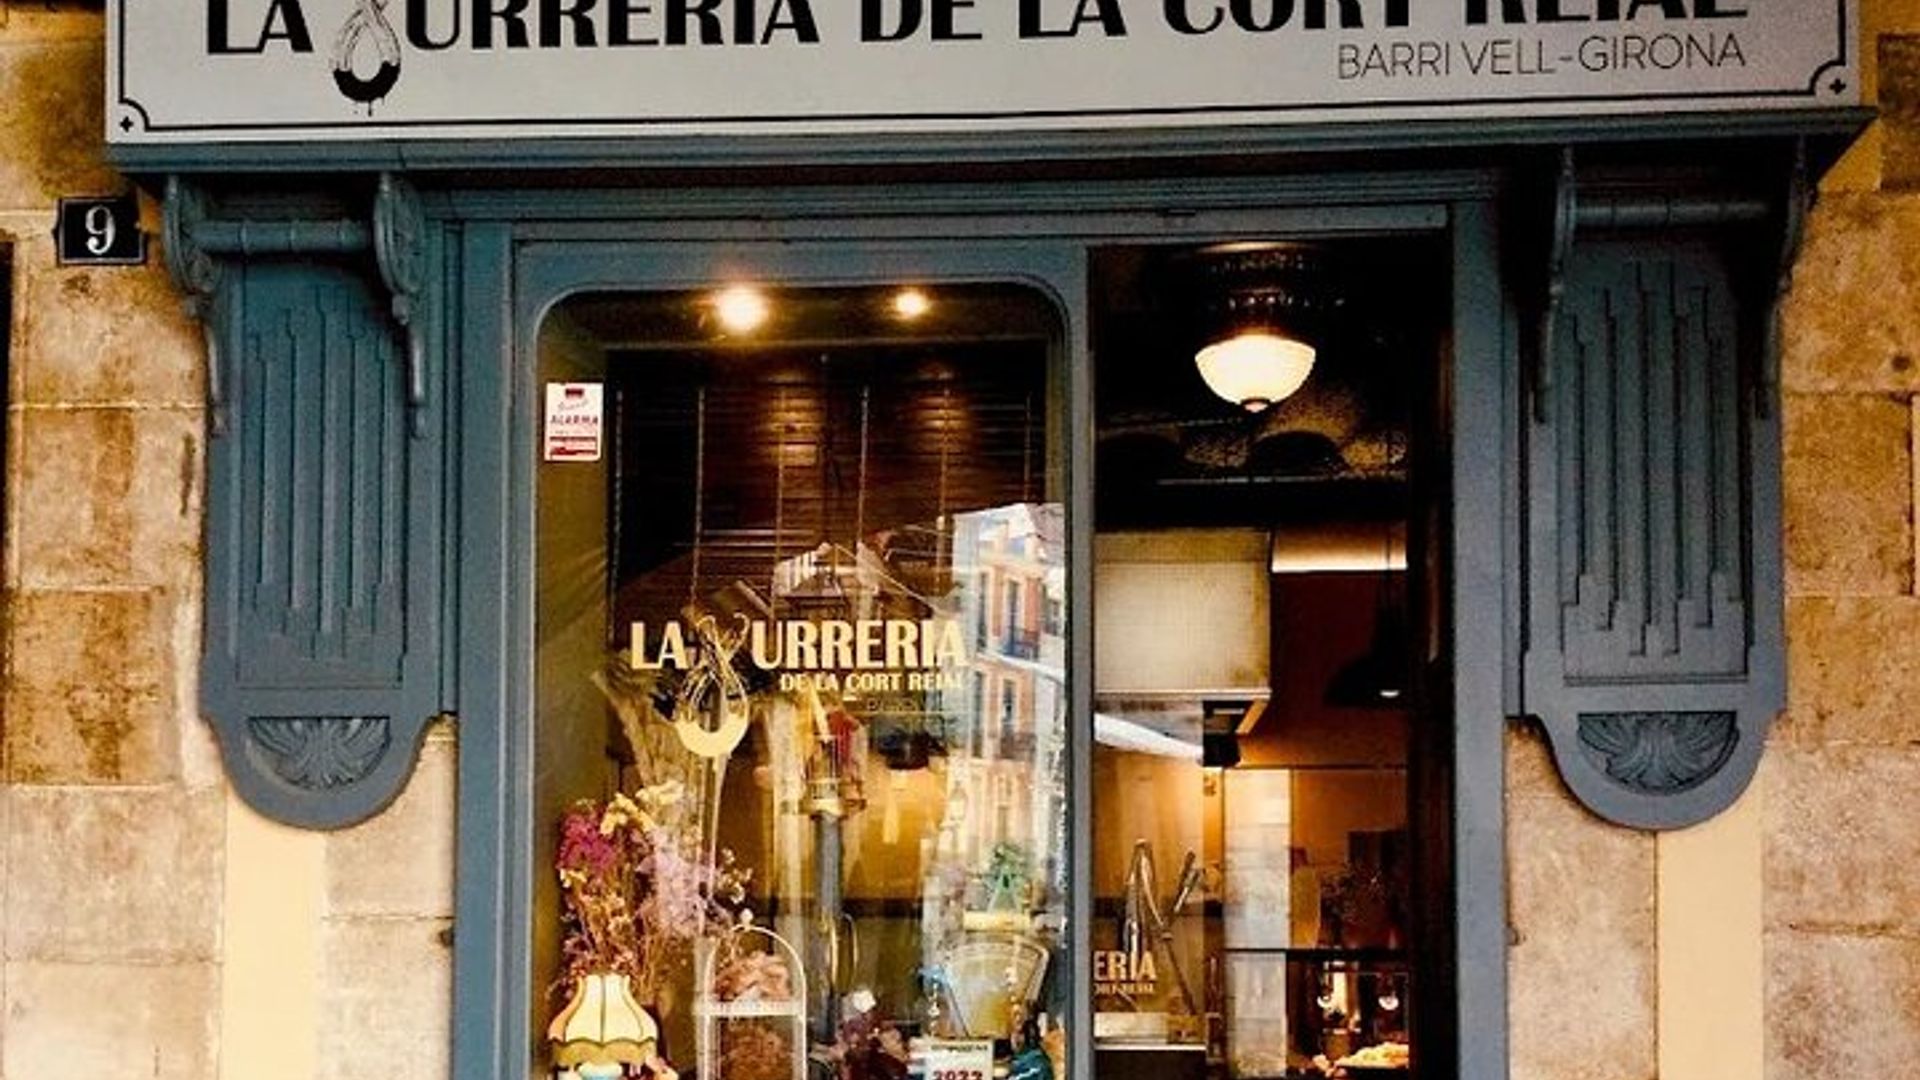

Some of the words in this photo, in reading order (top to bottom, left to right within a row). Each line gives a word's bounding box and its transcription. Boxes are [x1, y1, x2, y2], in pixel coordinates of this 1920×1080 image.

[206, 0, 314, 54] LA
[860, 0, 983, 42] DE
[1019, 0, 1128, 39] LA
[1338, 41, 1451, 79] BARRI
[1461, 32, 1746, 75] VELL-GIRONA
[85, 205, 116, 255] 9
[630, 621, 689, 669] LA
[845, 673, 901, 691] CORT
